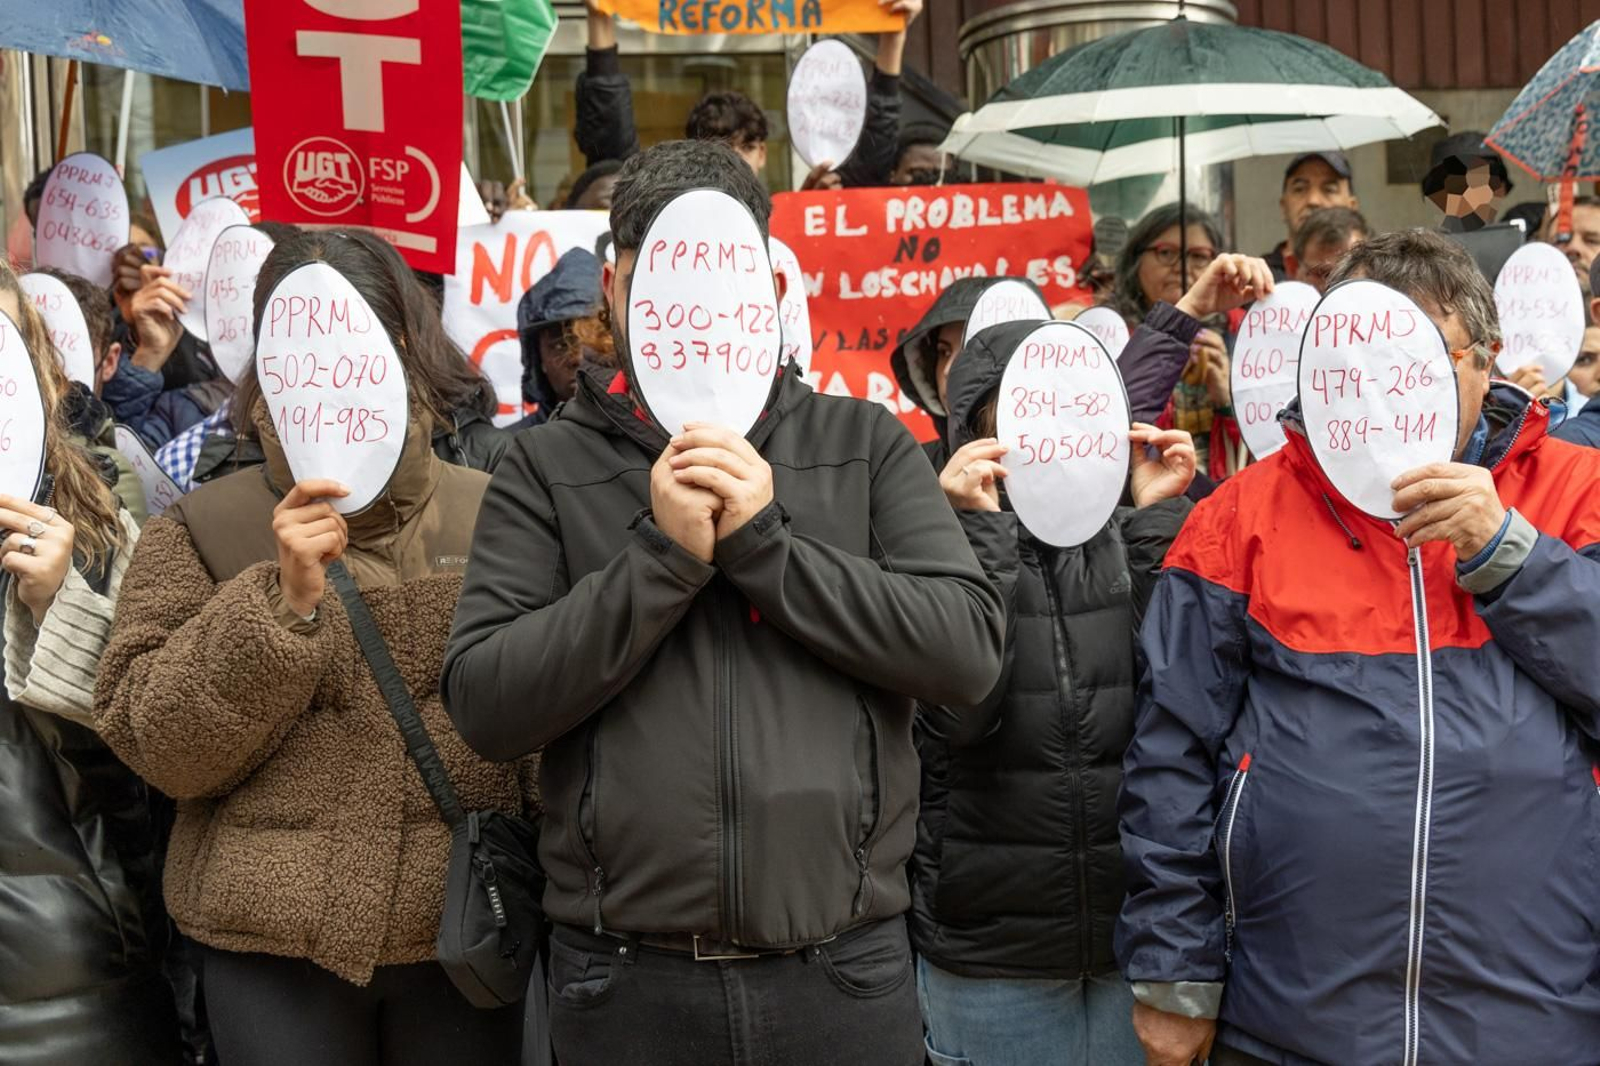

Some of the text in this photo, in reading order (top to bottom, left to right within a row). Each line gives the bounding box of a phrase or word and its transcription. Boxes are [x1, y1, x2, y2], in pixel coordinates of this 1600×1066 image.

[56, 163, 115, 187] PPRMJ
[296, 151, 352, 183] UGT
[368, 157, 410, 182] FSP
[804, 190, 1074, 236] EL PROBLEMA
[650, 239, 757, 273] PPRMJ
[894, 235, 941, 263] NO
[271, 296, 371, 337] PPRMJ
[635, 300, 775, 334] 300-122
[1315, 309, 1417, 348] PPRMJ
[837, 328, 889, 351] LAS
[1023, 344, 1101, 369] PPRMJ
[263, 353, 387, 394] 502-070
[641, 340, 773, 377] 837900
[1011, 386, 1111, 418] 854-582
[278, 402, 388, 444] 191-985
[1018, 431, 1119, 466] 505012
